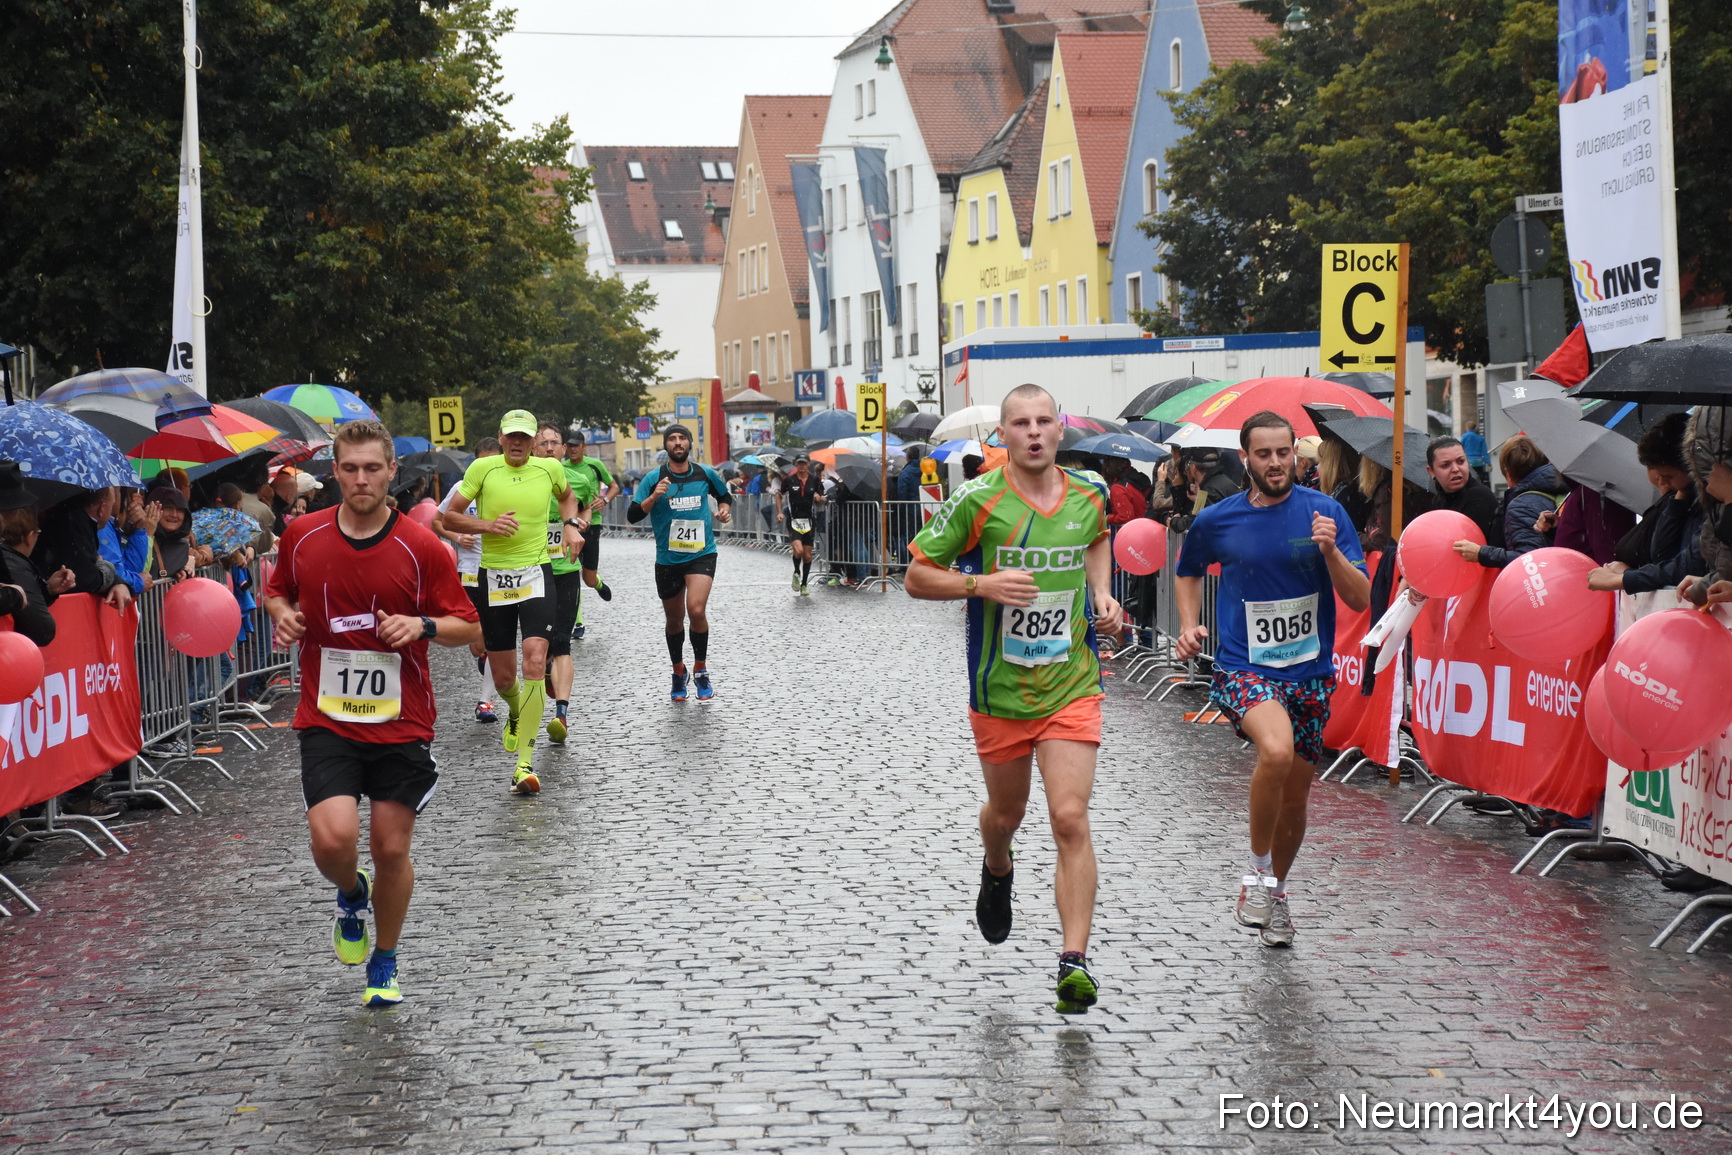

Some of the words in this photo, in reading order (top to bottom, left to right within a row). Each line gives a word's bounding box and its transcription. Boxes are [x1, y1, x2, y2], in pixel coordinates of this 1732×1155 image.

[1528, 197, 1551, 208] Ulmer
[1553, 196, 1563, 206] Ga
[1332, 249, 1398, 272] Block
[980, 266, 1000, 289] HOTEL
[1341, 282, 1386, 345] C
[860, 385, 883, 394] Block
[432, 400, 459, 409] Block
[864, 398, 879, 421] D
[438, 412, 456, 436] D
[669, 495, 701, 506] HUBER
[547, 531, 562, 545] 26
[676, 527, 697, 540] 241
[996, 544, 1089, 572] BOCK
[495, 574, 523, 589] 287
[503, 591, 520, 599] Sorin
[342, 618, 363, 628] DEHN
[1010, 608, 1067, 639] 2852
[1255, 610, 1312, 644] 3058
[1262, 650, 1299, 661] Andreas
[337, 668, 386, 696] 170
[342, 702, 376, 714] Martin
